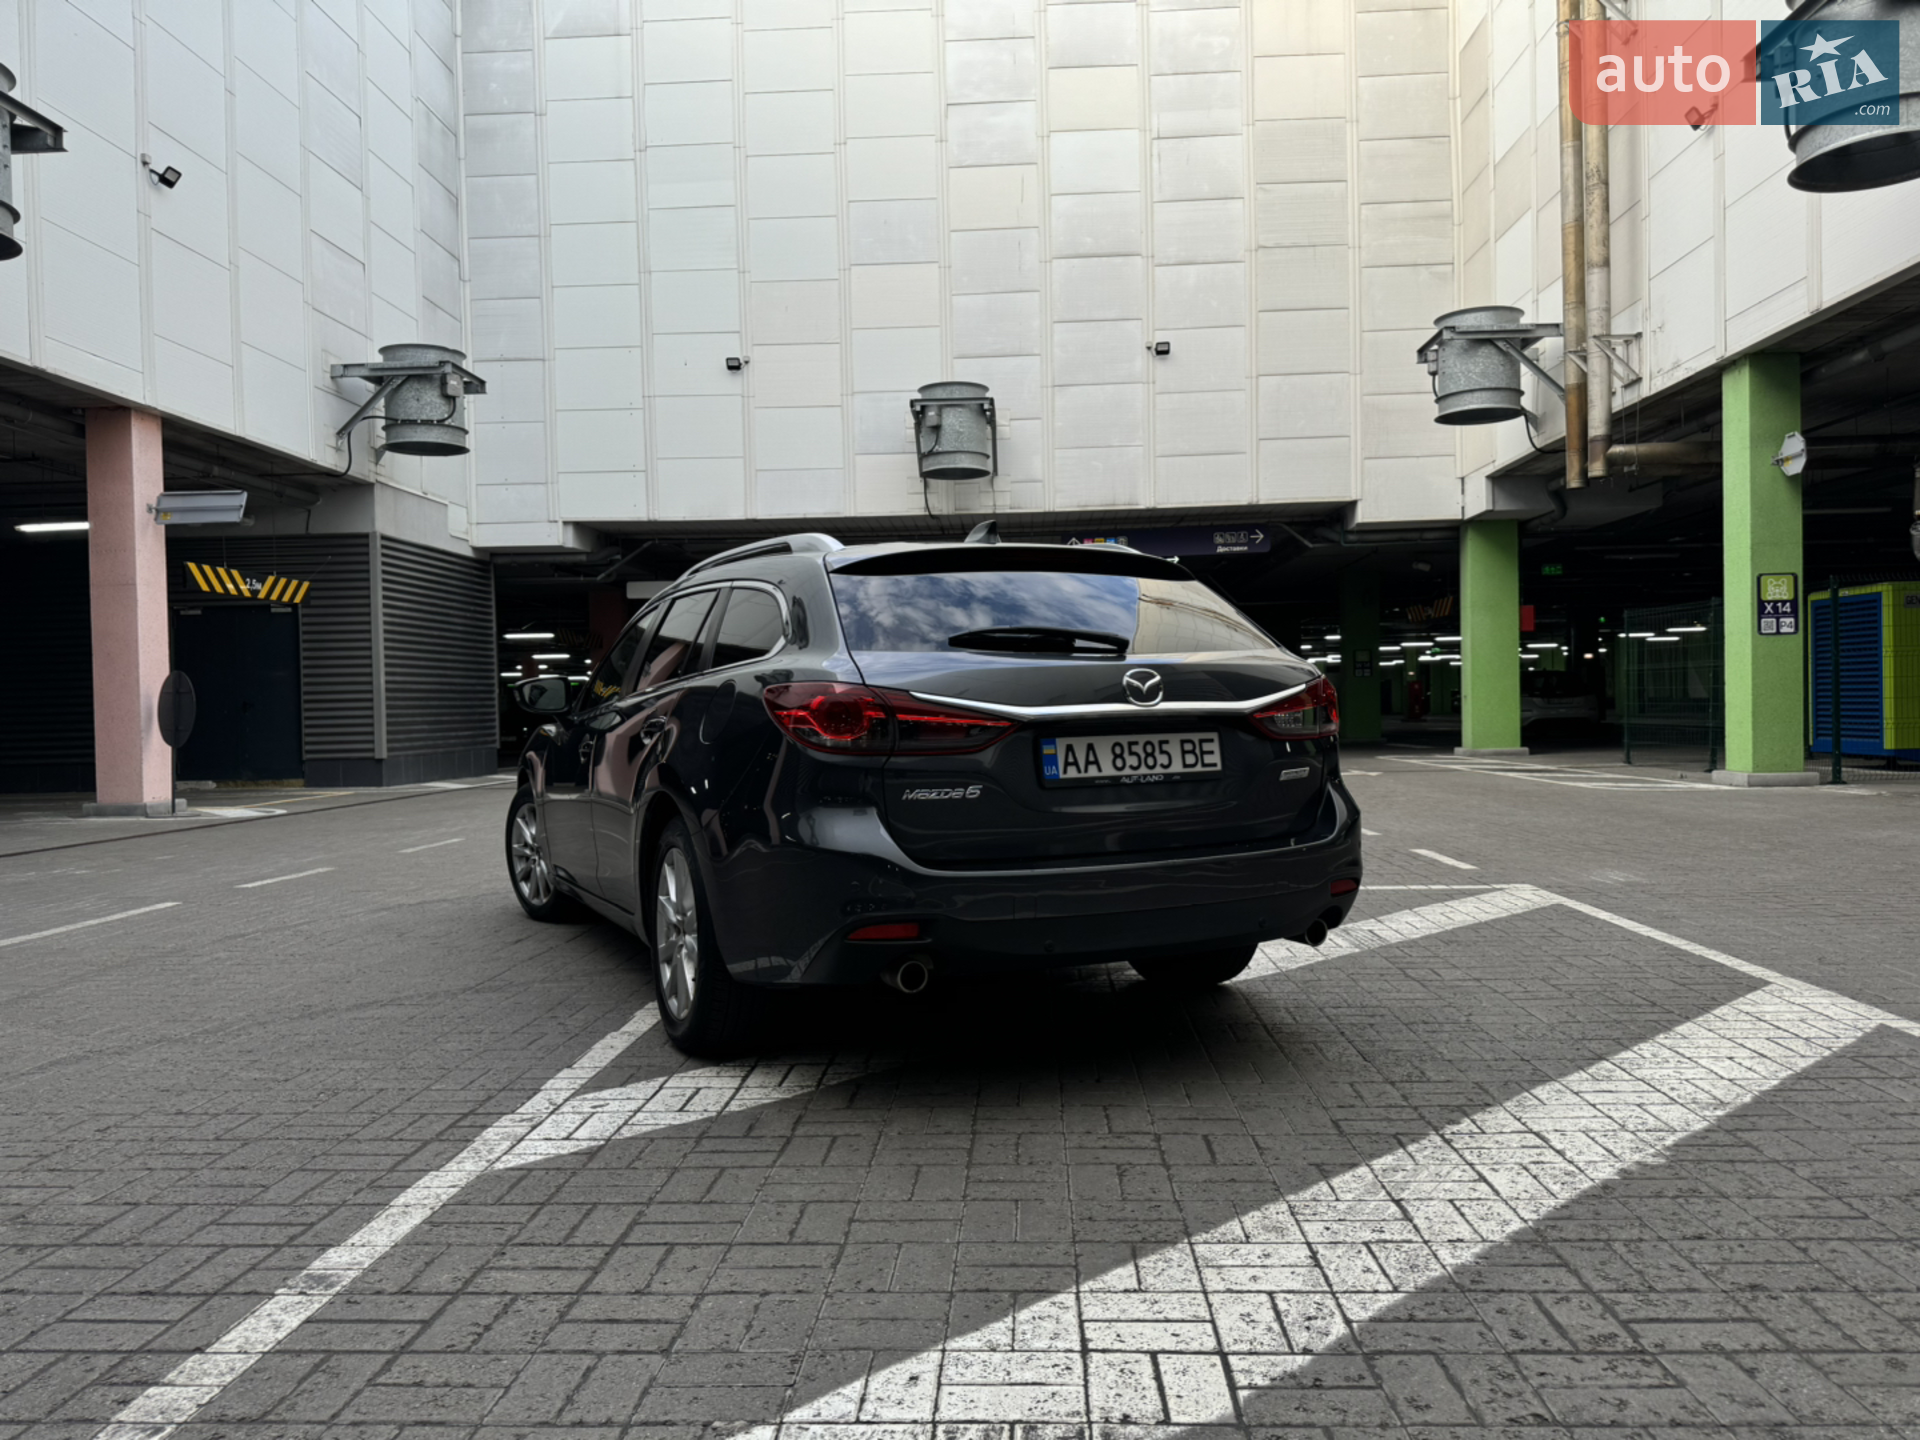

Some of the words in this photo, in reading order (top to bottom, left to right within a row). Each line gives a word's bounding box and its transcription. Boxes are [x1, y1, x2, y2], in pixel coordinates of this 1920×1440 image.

[1764, 602, 1774, 614] X
[1776, 601, 1792, 613] 14
[1780, 620, 1794, 630] P4
[1062, 743, 1103, 775] AA
[1110, 740, 1173, 771] 8585
[1179, 738, 1218, 769] BE
[1044, 765, 1058, 776] UA
